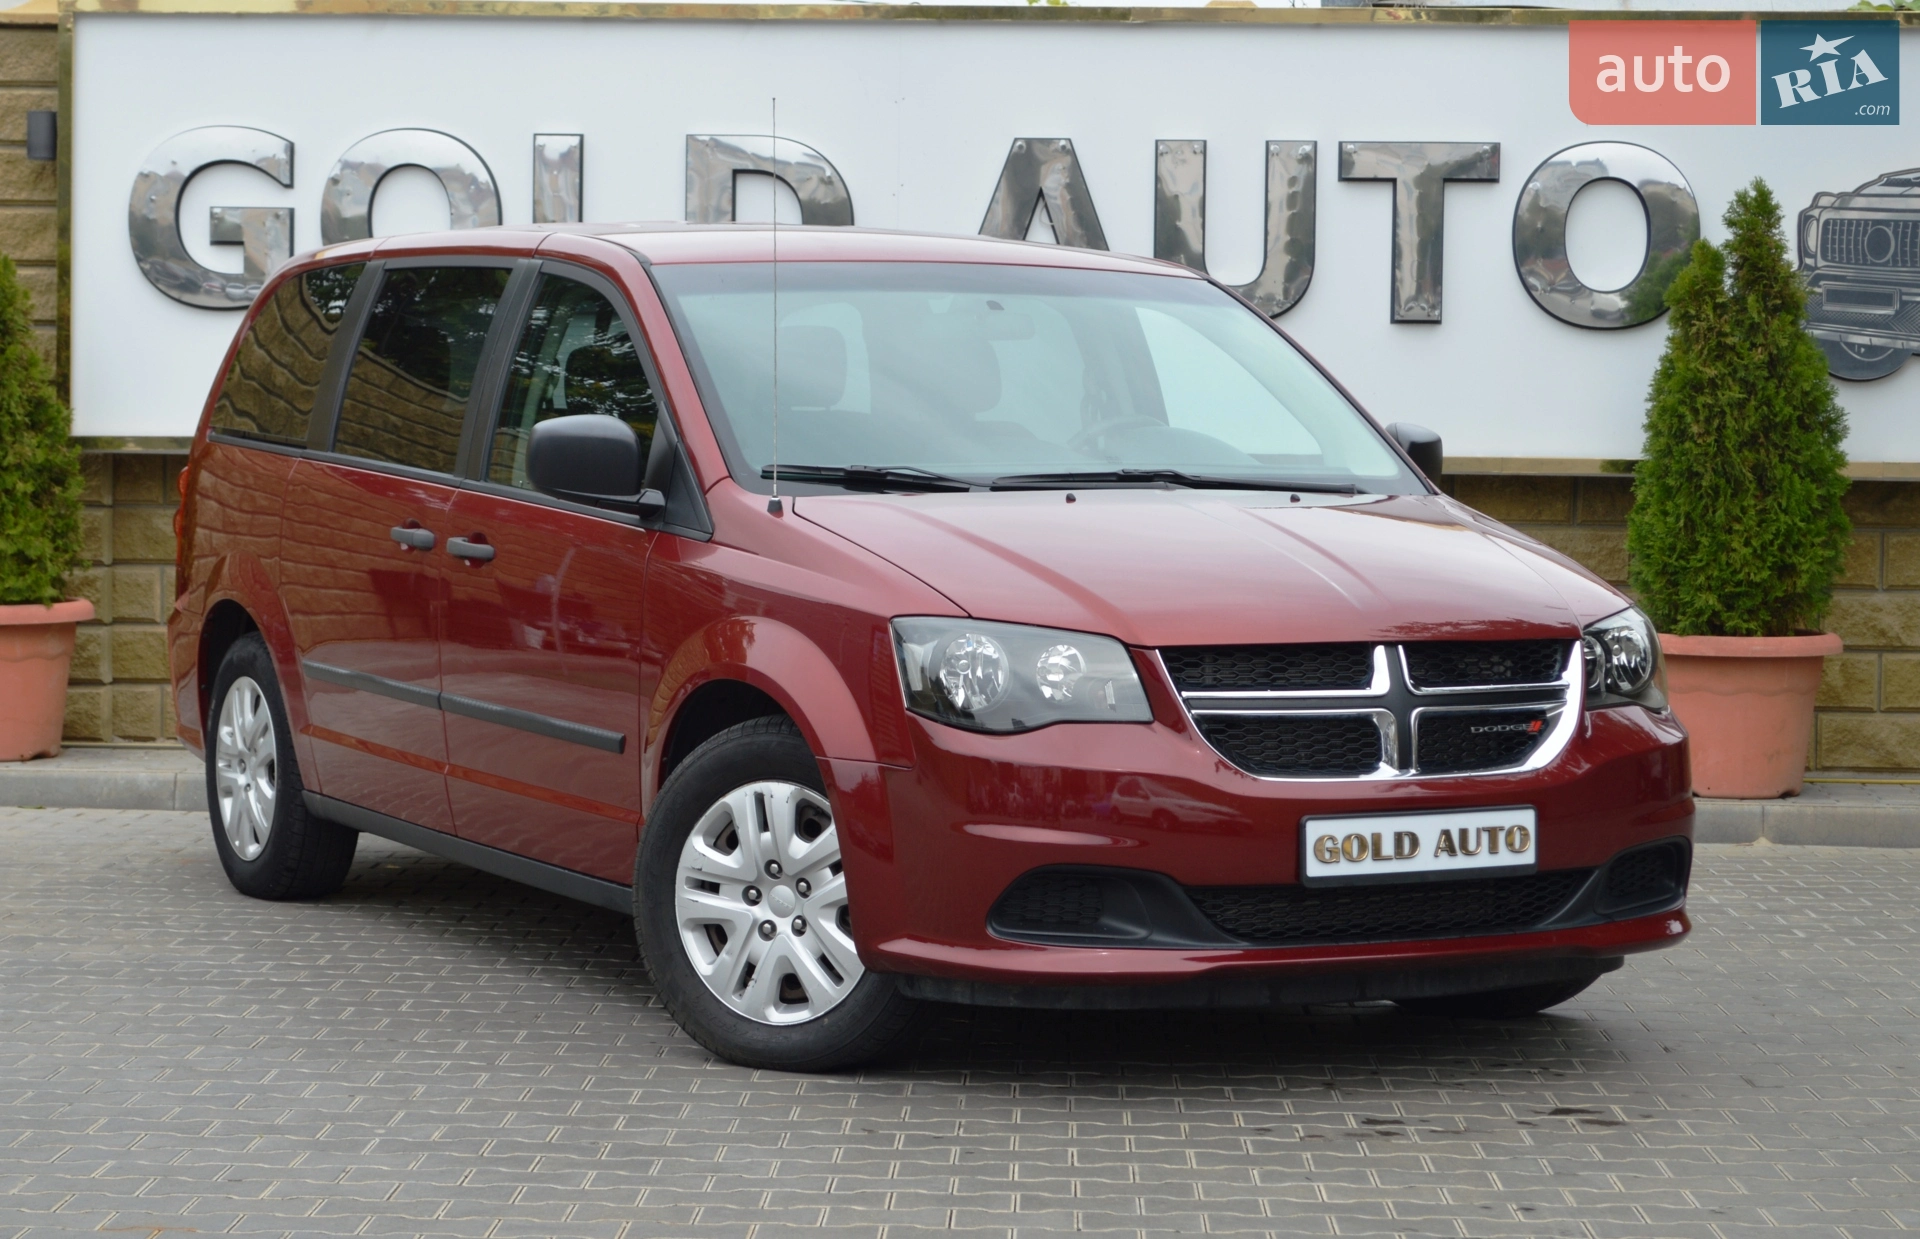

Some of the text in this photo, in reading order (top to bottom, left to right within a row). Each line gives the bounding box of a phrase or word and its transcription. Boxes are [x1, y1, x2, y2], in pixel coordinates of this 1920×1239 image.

[1470, 723, 1531, 734] DODGE
[1313, 824, 1532, 864] GOLD AUTO
